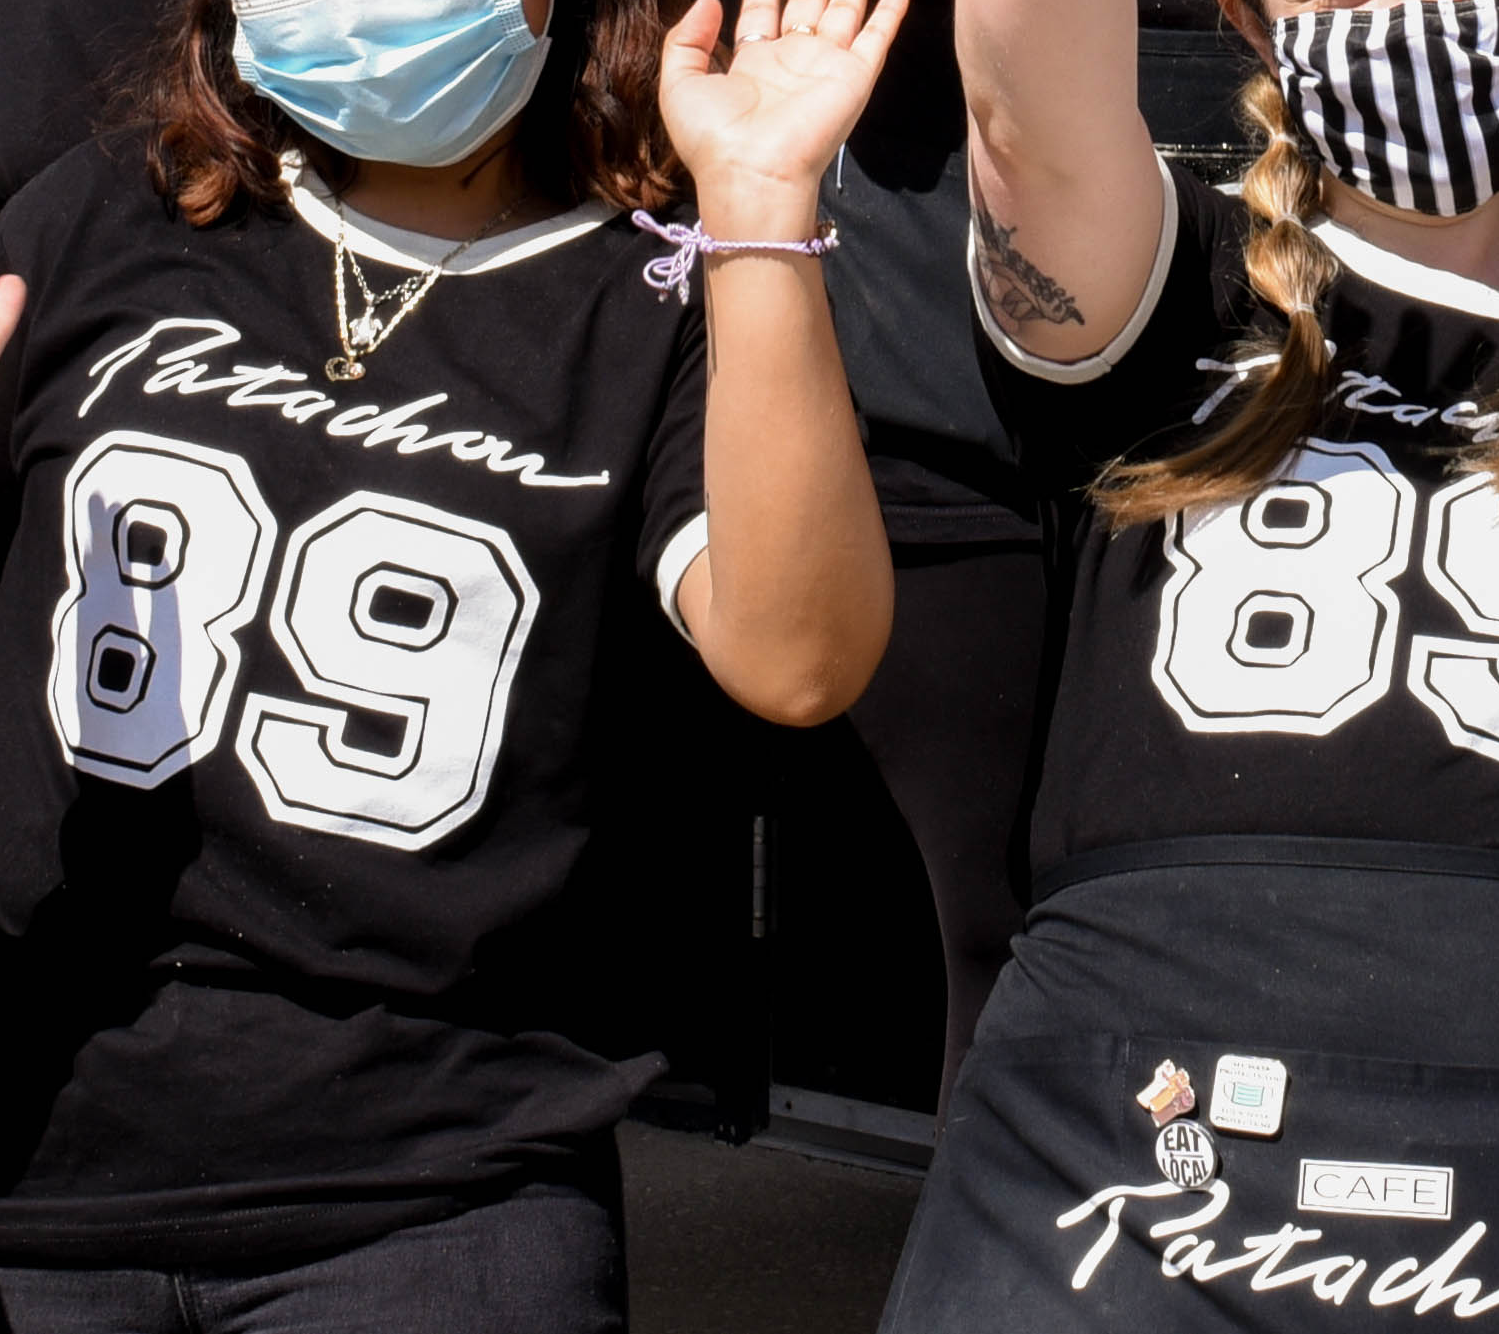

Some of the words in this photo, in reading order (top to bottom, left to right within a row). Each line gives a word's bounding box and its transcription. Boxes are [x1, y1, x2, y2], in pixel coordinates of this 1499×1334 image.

[78, 318, 610, 488] Patachou
[46, 429, 541, 853] 89
[1164, 1126, 1201, 1152] EAT
[1162, 1157, 1209, 1187] LOCAL
[1313, 1172, 1438, 1206] CAFE
